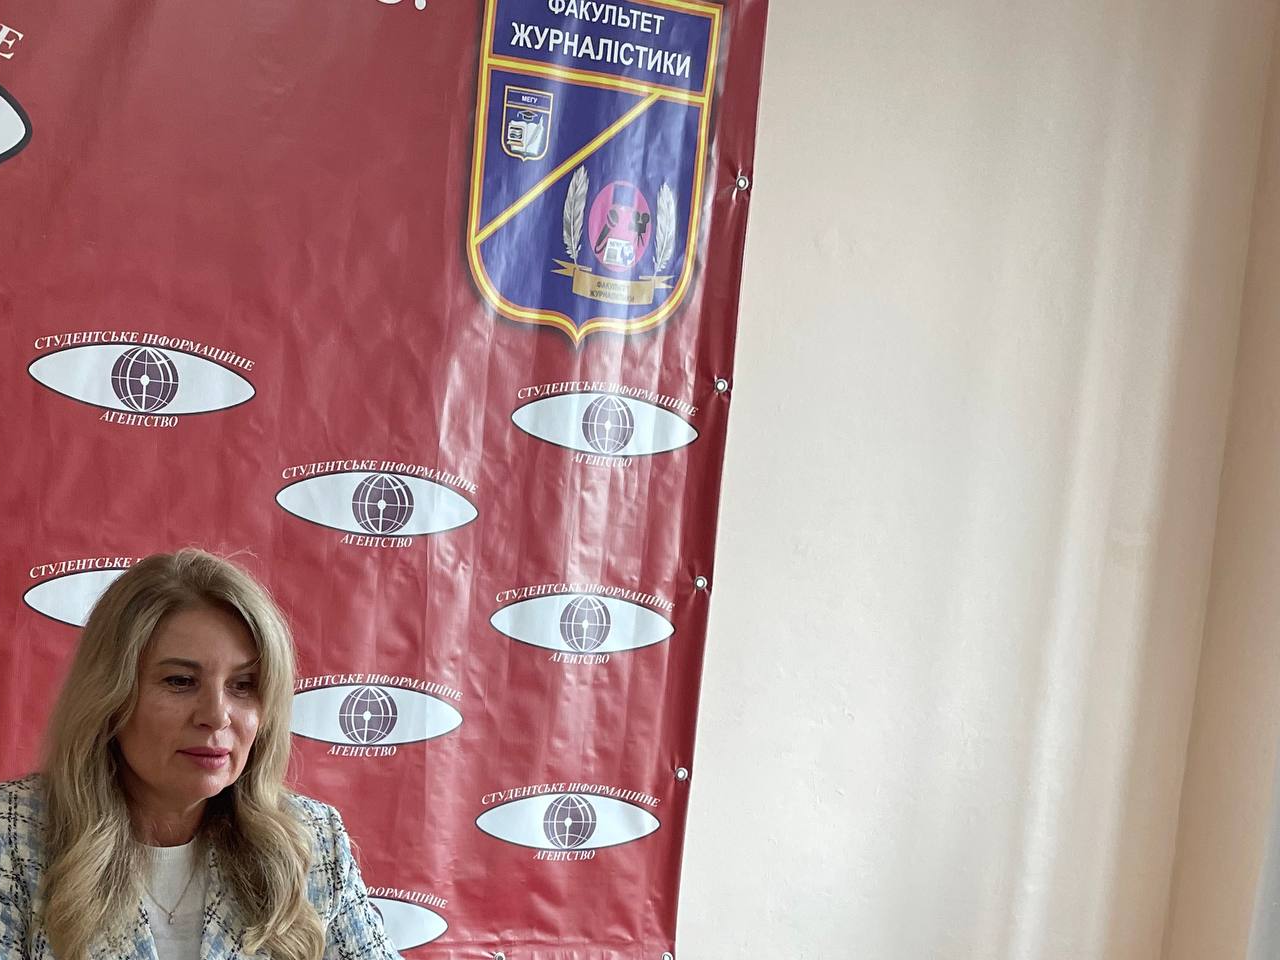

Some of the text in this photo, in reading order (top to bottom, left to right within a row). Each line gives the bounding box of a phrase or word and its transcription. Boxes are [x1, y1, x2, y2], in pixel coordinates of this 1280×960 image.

[548, 0, 664, 35] ФАКУЛЬТЕТ
[510, 22, 691, 78] ЖУРНАЛІСТИКИ
[521, 96, 538, 104] МЕГУ
[35, 331, 255, 371] СТУДЕНТСЬКЕ ІНФОРМАЦІЙНЕ
[100, 411, 178, 427] АГЕНТСТВО
[282, 460, 378, 479] СТУДЕНТСЬКЕ
[340, 534, 412, 548] АГЕНТСТВО
[30, 557, 132, 578] СТУДЕНТСЬКЕ
[549, 653, 610, 665] АГЕНТСТВО
[294, 674, 363, 690] ДЕНТСЬКЕ
[327, 745, 397, 757] АГЕНТСТВО
[481, 783, 566, 804] СТУДЕНТСЬКЕ
[533, 849, 595, 861] АГЕНТСТВО
[366, 886, 449, 909] ФОРМАЦІЙНЕ
